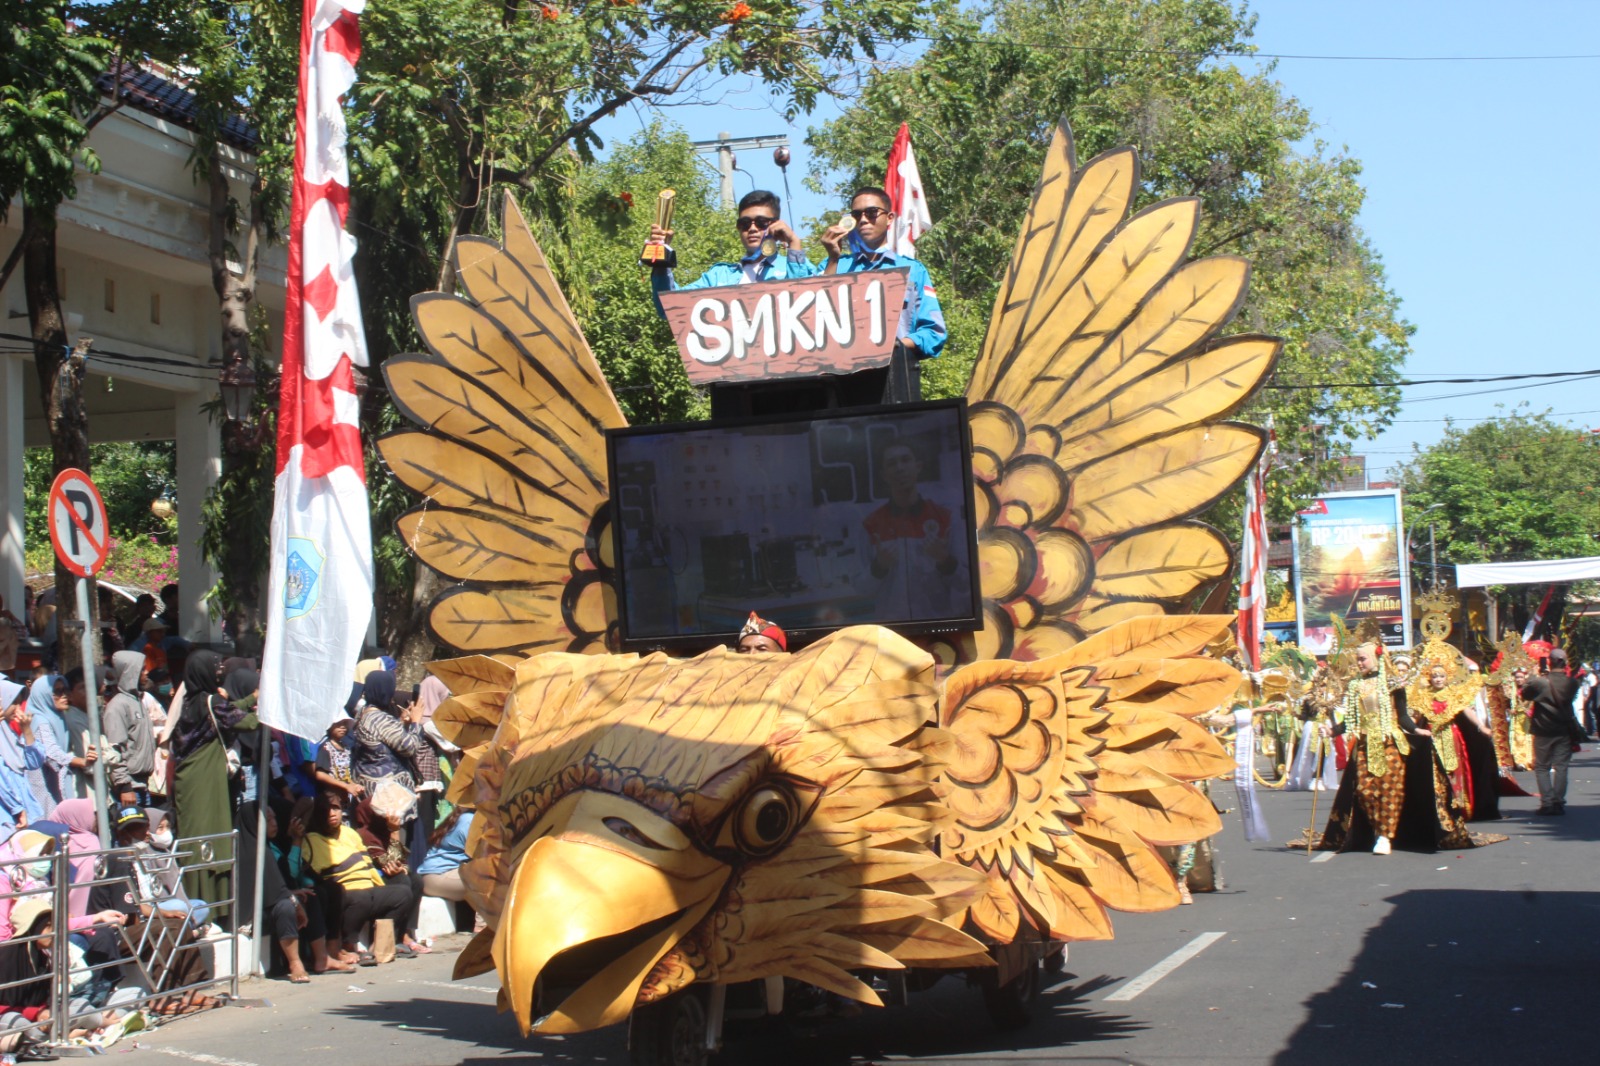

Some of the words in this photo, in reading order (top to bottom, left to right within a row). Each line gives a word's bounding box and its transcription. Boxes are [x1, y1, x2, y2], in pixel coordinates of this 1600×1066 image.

[686, 283, 853, 363] SMKN
[864, 280, 883, 344] 1
[65, 489, 94, 556] P
[1356, 599, 1402, 613] NUSANTARA
